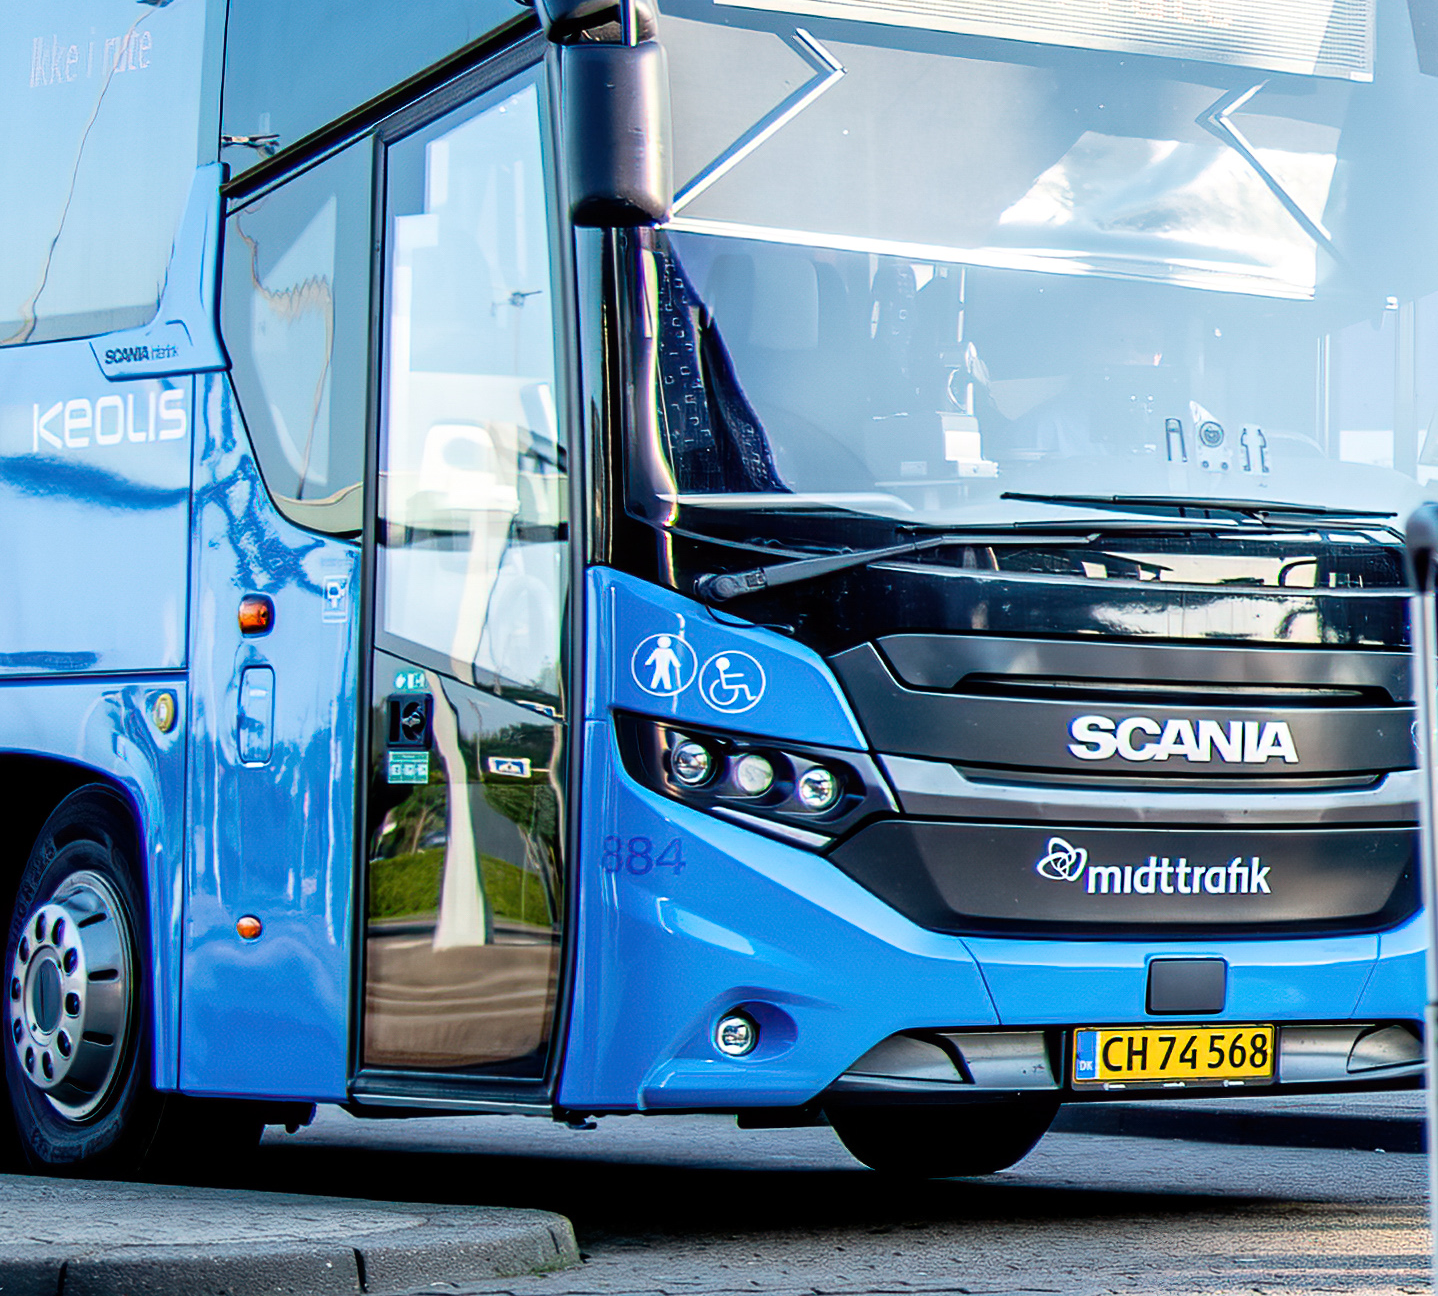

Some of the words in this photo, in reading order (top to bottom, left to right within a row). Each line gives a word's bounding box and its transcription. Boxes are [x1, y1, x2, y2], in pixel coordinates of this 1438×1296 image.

[1067, 715, 1299, 763] SCANIA
[1087, 856, 1272, 894] midttrafik
[1079, 1062, 1093, 1071] DK
[1102, 1036, 1148, 1071] CH
[1158, 1035, 1197, 1070] 74
[1207, 1033, 1268, 1069] 568
